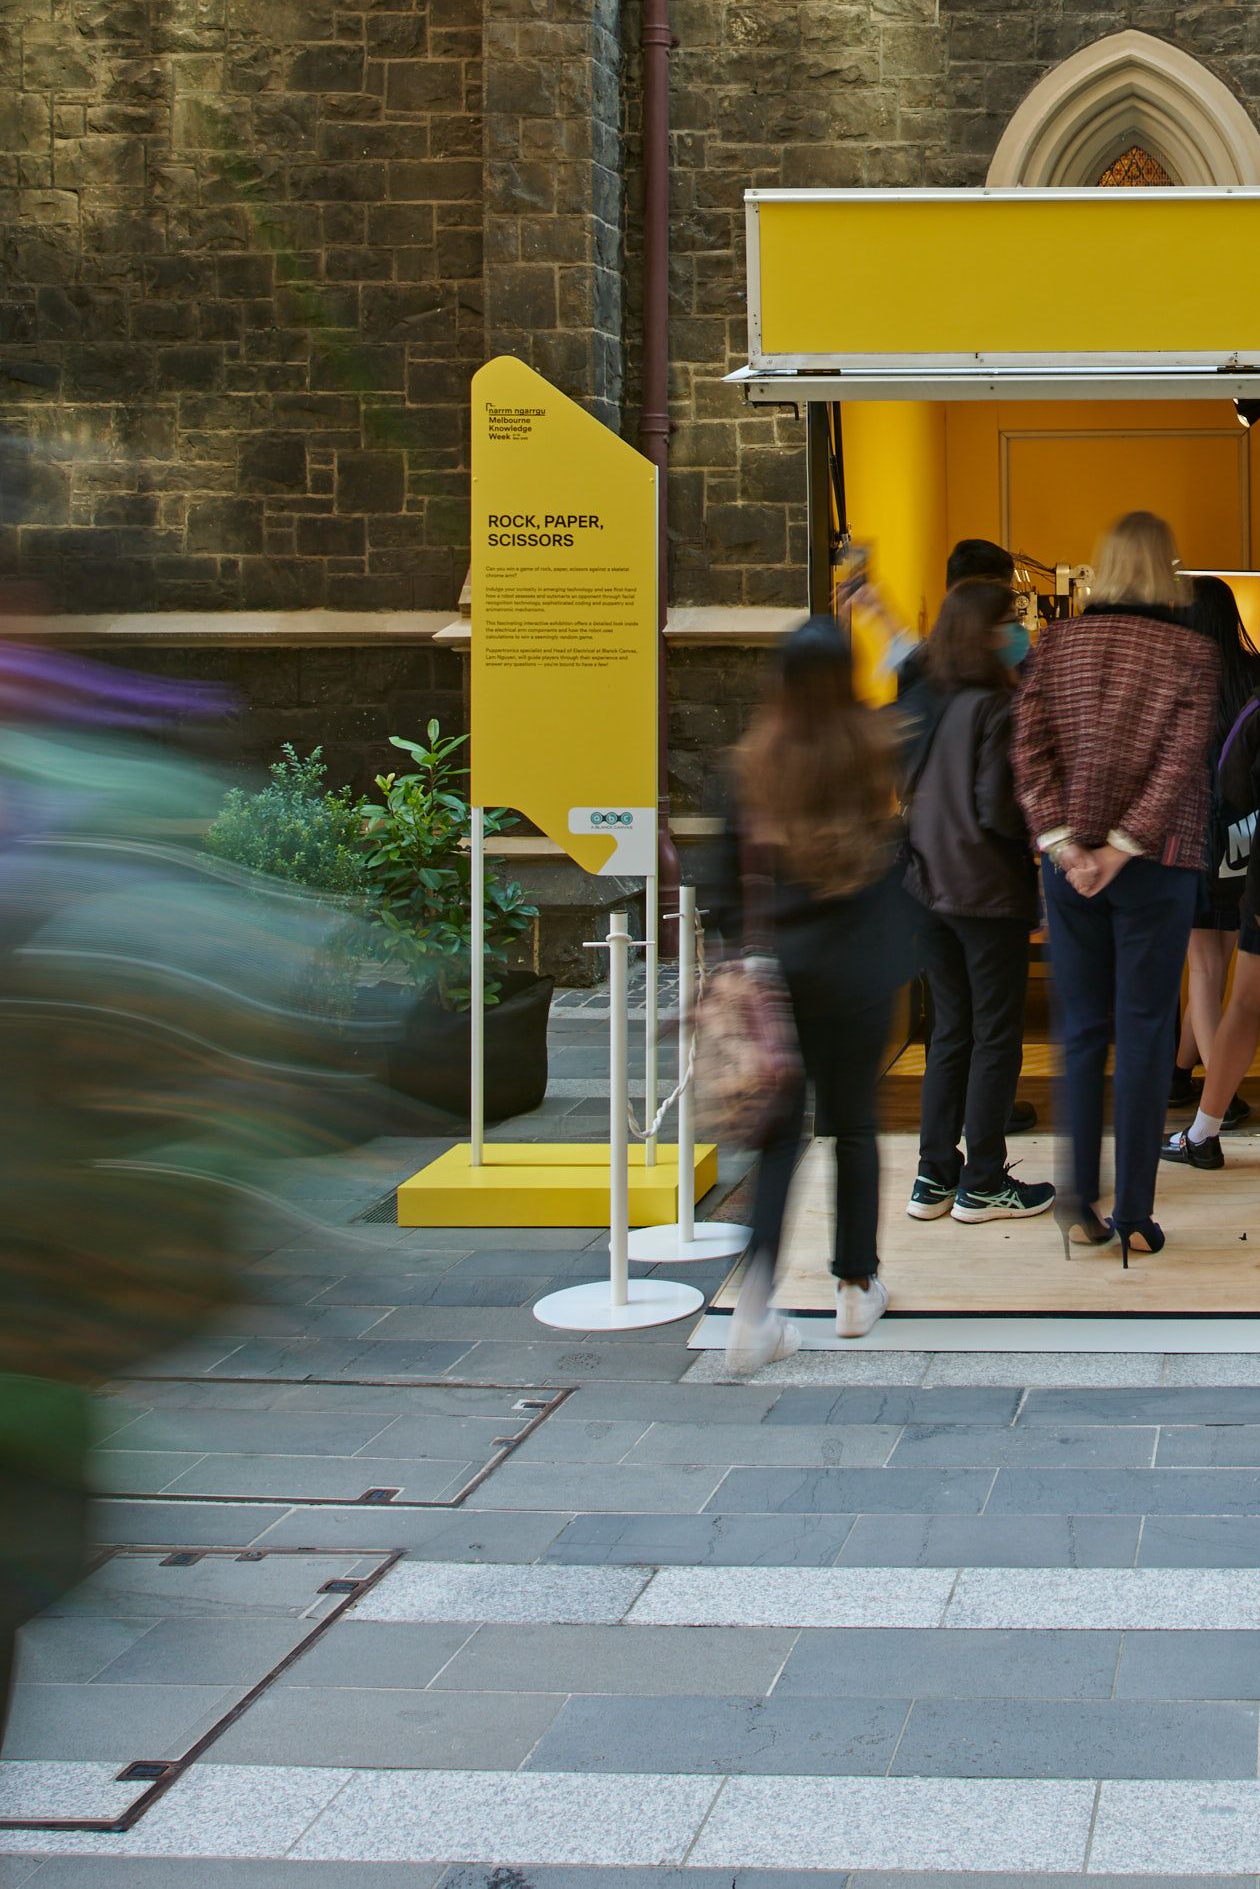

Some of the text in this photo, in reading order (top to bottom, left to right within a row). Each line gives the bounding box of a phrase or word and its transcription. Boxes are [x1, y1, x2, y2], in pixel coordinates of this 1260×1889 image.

[488, 416, 531, 424] Melbourne
[488, 424, 532, 433] Knowledge
[488, 514, 604, 530] ROCK, PAPER,
[488, 533, 574, 547] SCISSORS
